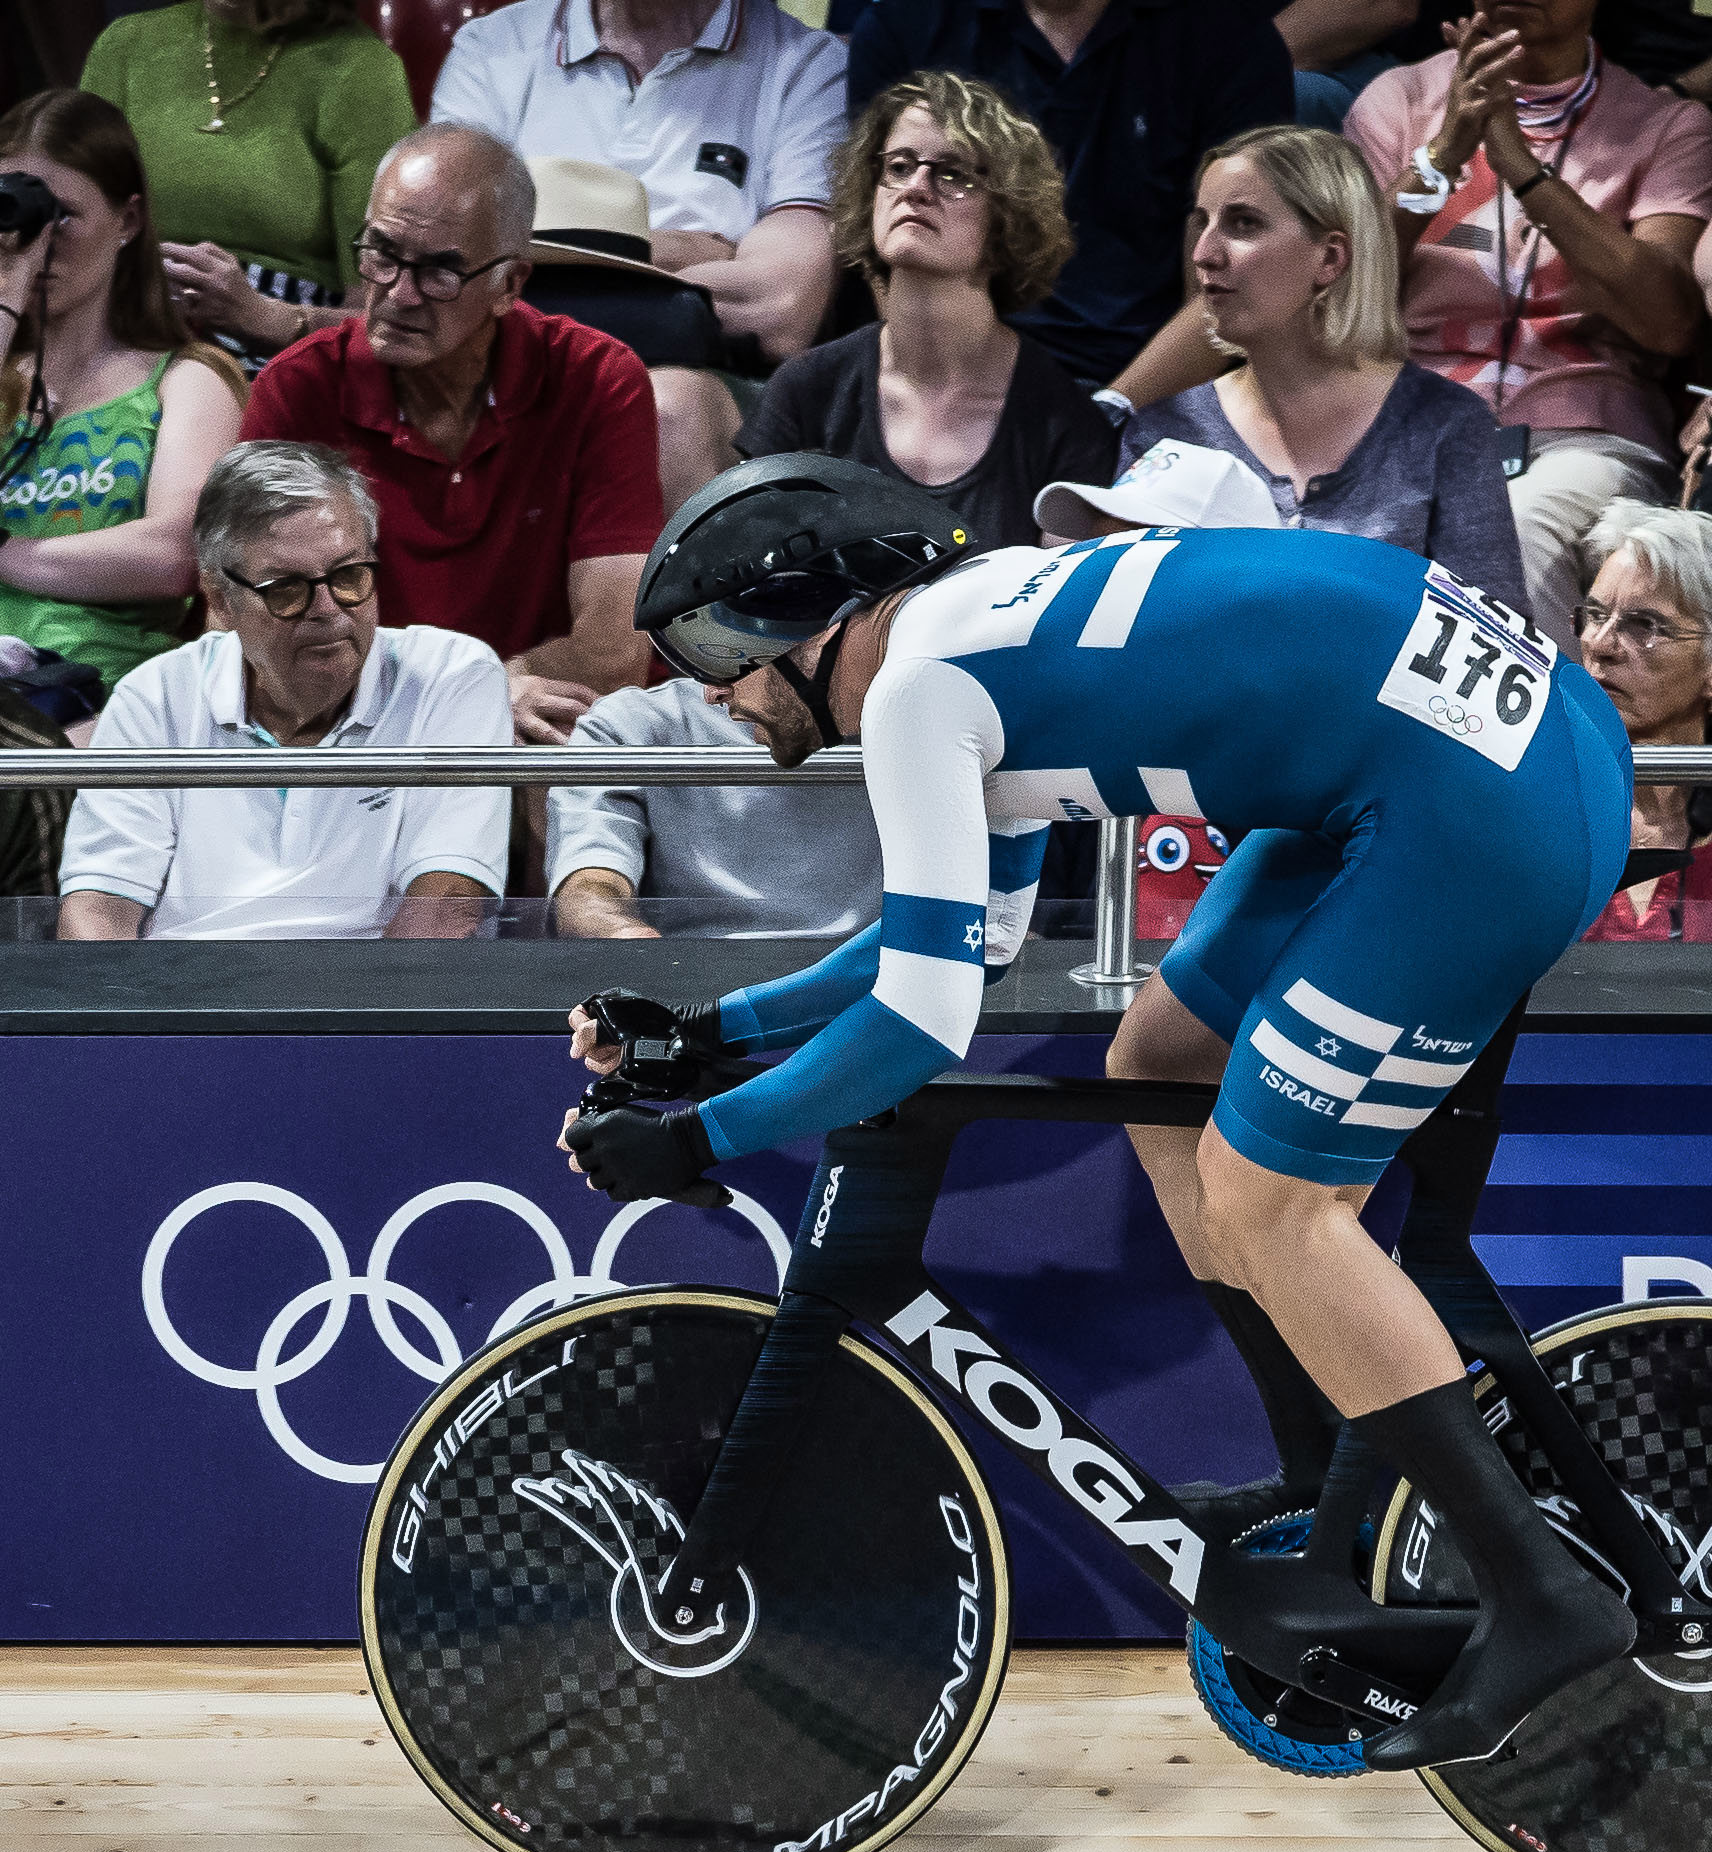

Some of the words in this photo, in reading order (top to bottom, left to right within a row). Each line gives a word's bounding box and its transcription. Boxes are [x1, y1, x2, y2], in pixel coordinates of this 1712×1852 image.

[1407, 611, 1538, 726] 176
[1412, 1024, 1473, 1053] ישראל
[1258, 1063, 1335, 1117] ISRAEL
[810, 1165, 844, 1249] KOGA
[392, 1334, 587, 1574] GHIBLI
[885, 1289, 1205, 1605] KOGA
